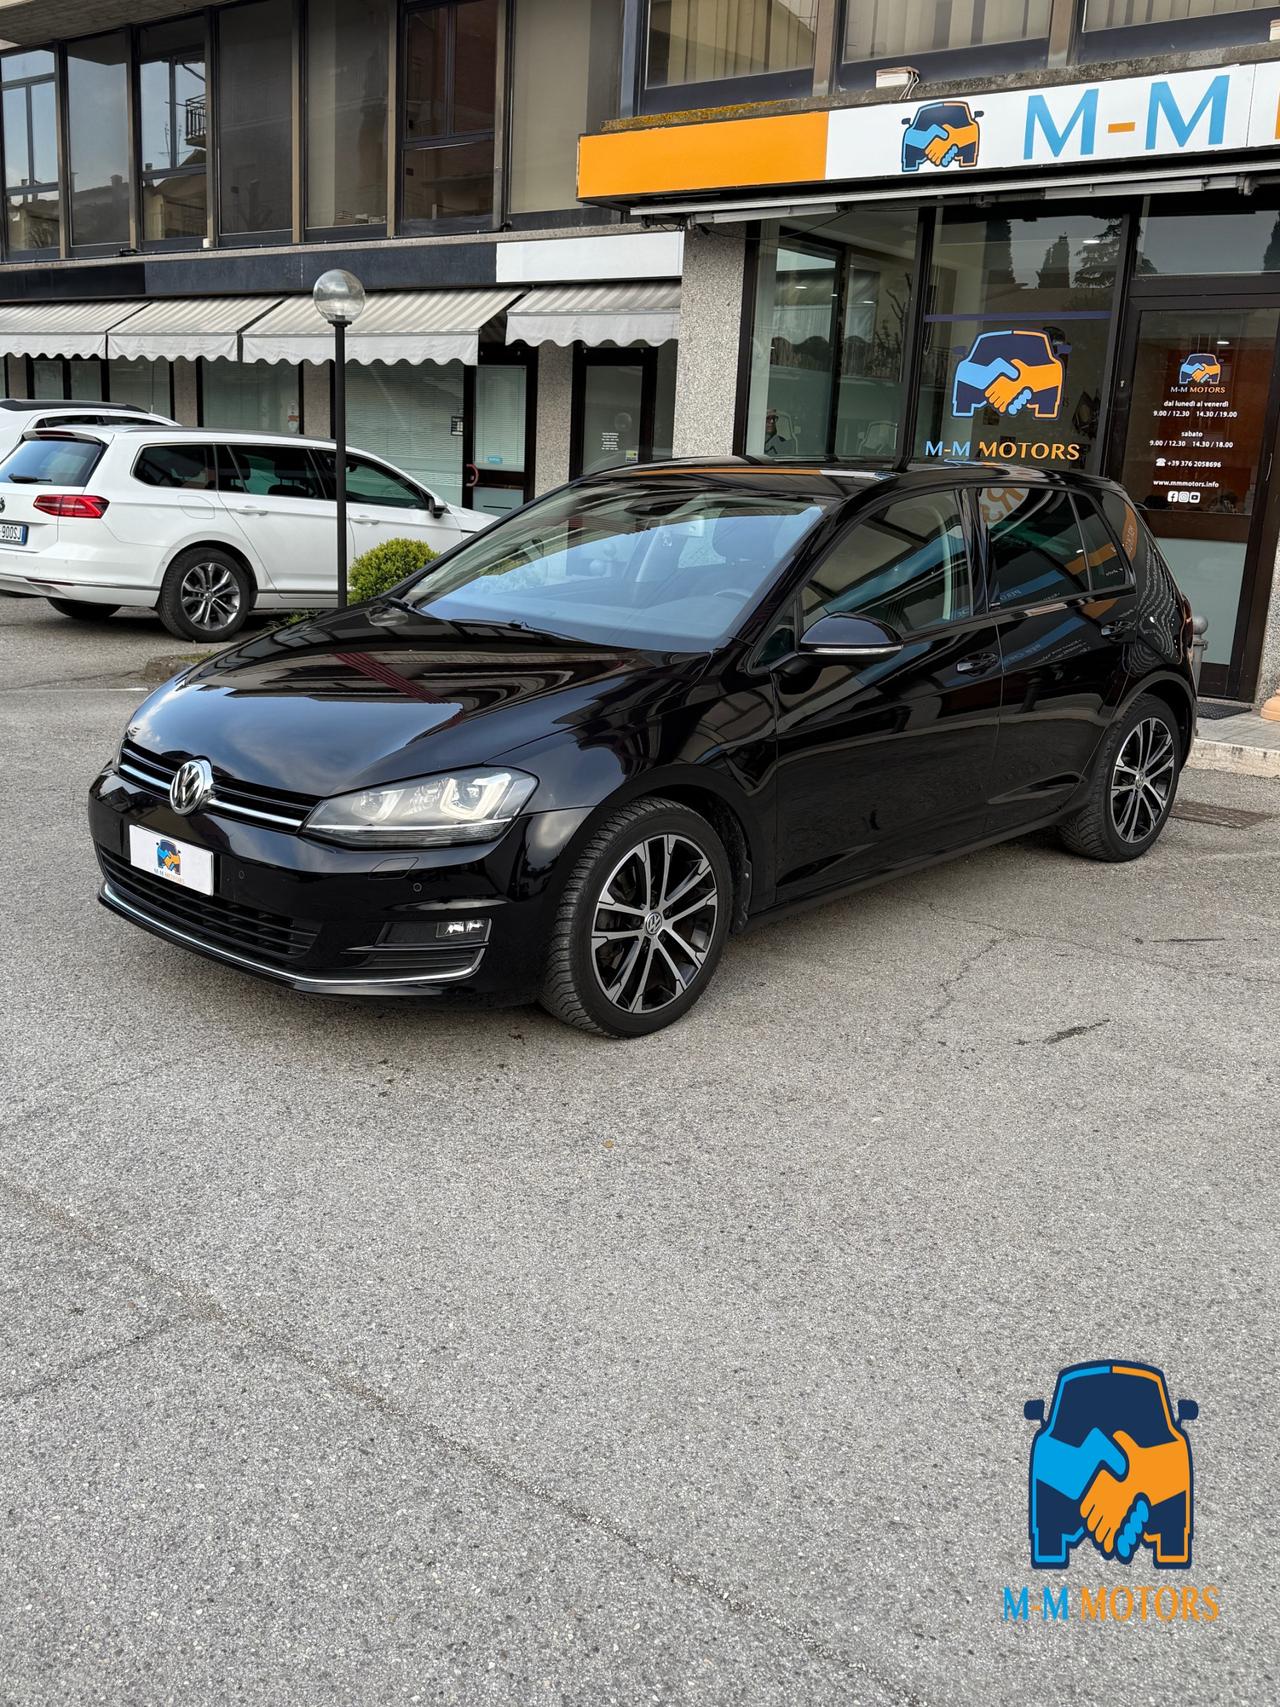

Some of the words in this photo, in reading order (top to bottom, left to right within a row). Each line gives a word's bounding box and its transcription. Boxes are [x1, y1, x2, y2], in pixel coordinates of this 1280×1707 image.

[1023, 74, 1230, 160] M-M
[1189, 386, 1226, 394] MOTORS
[1181, 430, 1203, 438] sabato
[924, 440, 971, 457] M-M
[979, 441, 1080, 460] MOTORS
[1153, 480, 1220, 488] www.mmmotors.info
